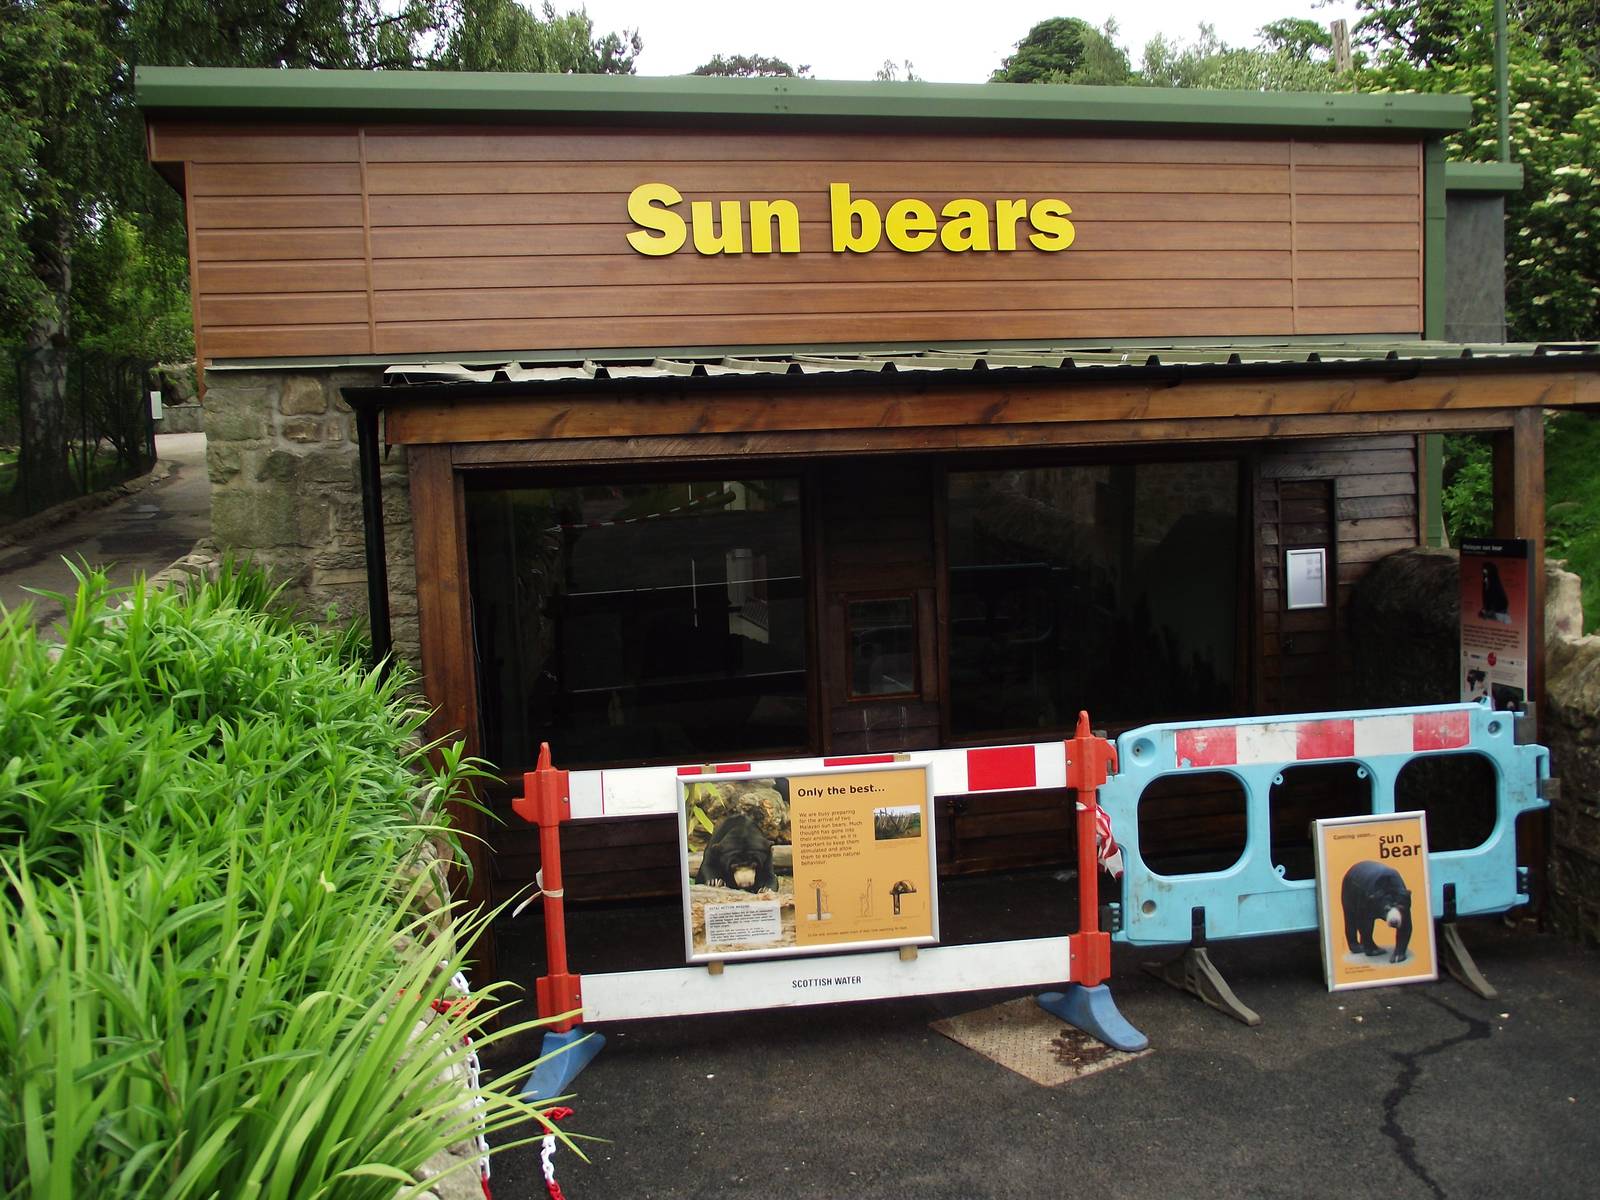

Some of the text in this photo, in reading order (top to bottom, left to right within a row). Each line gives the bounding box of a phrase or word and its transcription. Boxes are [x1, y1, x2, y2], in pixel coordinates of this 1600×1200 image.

[626, 182, 1076, 257] Sun bears
[797, 784, 885, 798] Only the best...
[1379, 833, 1404, 844] sun
[1379, 843, 1421, 859] bear
[792, 975, 862, 989] SCOTTISH WATER
